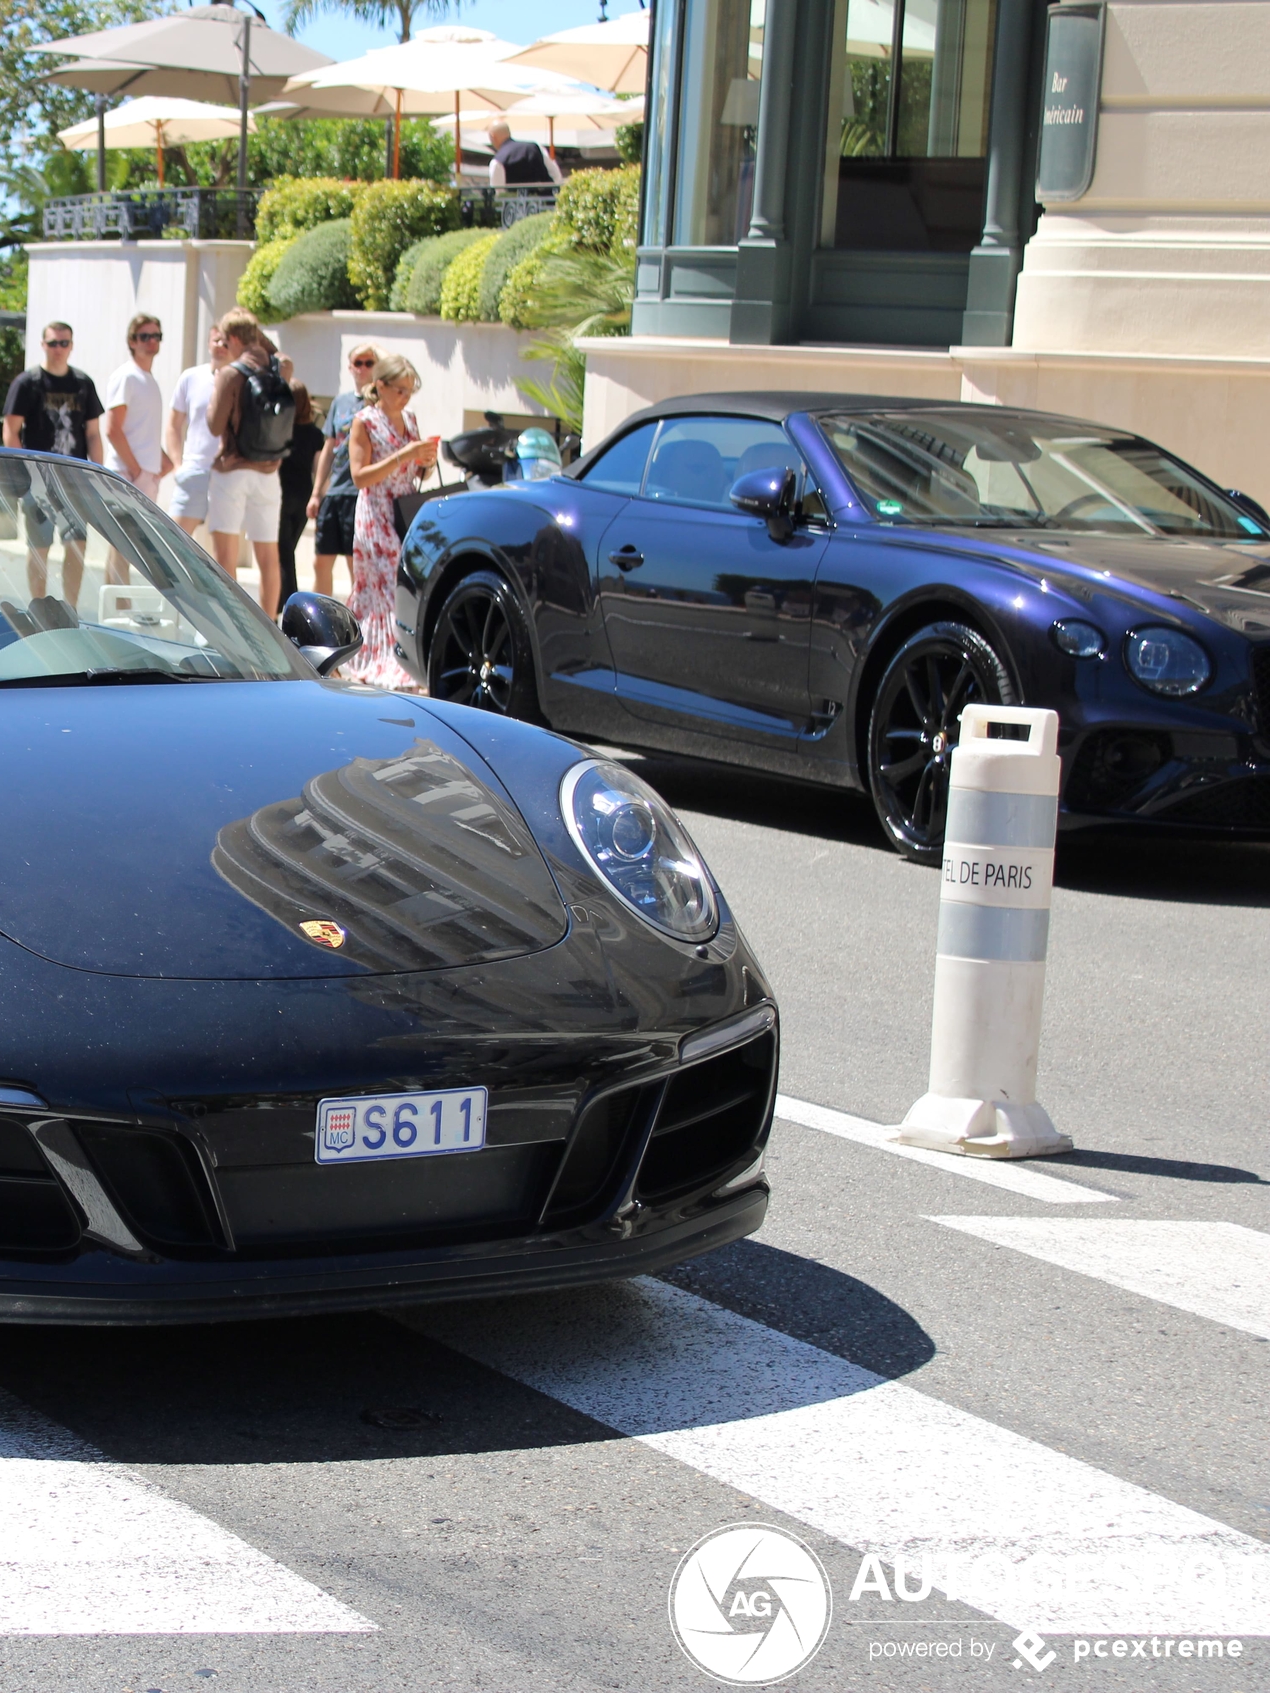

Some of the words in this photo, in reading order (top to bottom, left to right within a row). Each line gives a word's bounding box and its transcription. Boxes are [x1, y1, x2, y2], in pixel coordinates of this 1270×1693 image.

[1052, 71, 1068, 93] Bar
[959, 861, 979, 885] DE
[984, 863, 1032, 889] PARIS
[330, 1131, 348, 1145] MC
[362, 1098, 472, 1150] S611
